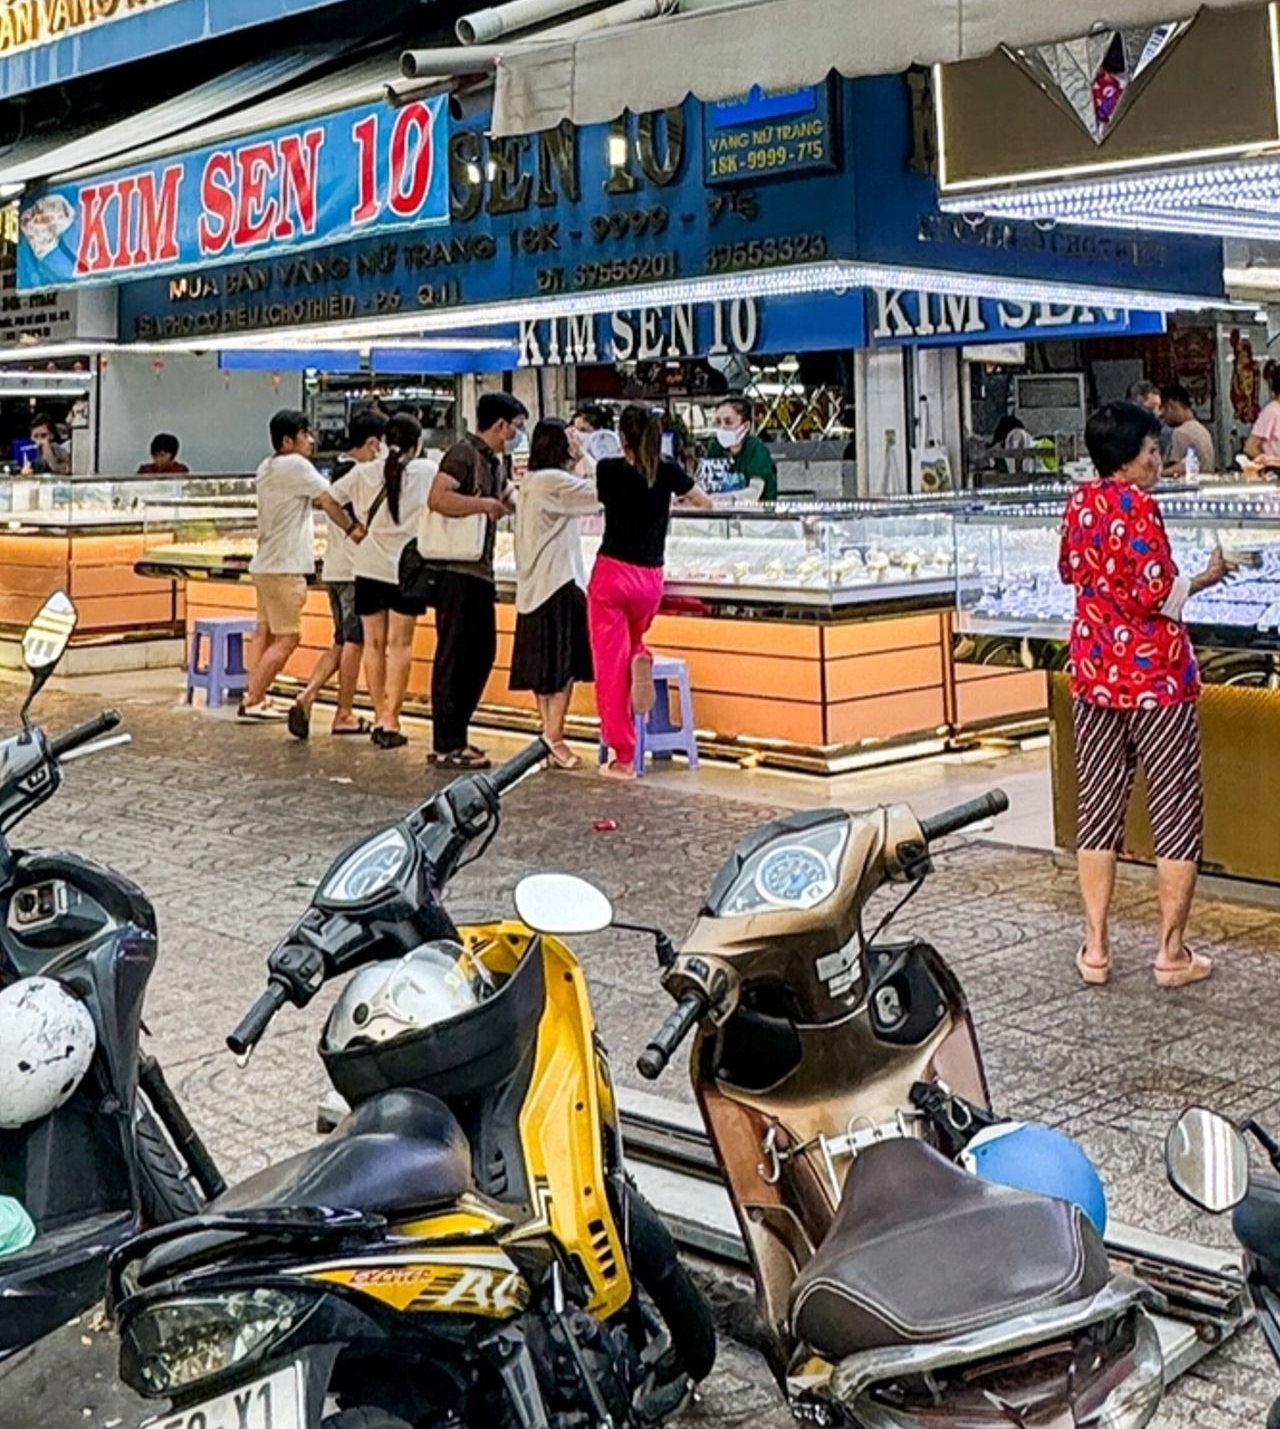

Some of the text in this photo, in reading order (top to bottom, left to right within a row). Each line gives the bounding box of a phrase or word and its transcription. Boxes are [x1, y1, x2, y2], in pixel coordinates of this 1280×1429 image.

[775, 119, 824, 141] TRANG
[74, 99, 435, 279] KIM SEN 10
[450, 117, 582, 222] SEN
[168, 276, 219, 301] MUA
[403, 232, 496, 267] TRANG
[517, 295, 759, 368] KIM SEN 10
[873, 286, 986, 340] KIM
